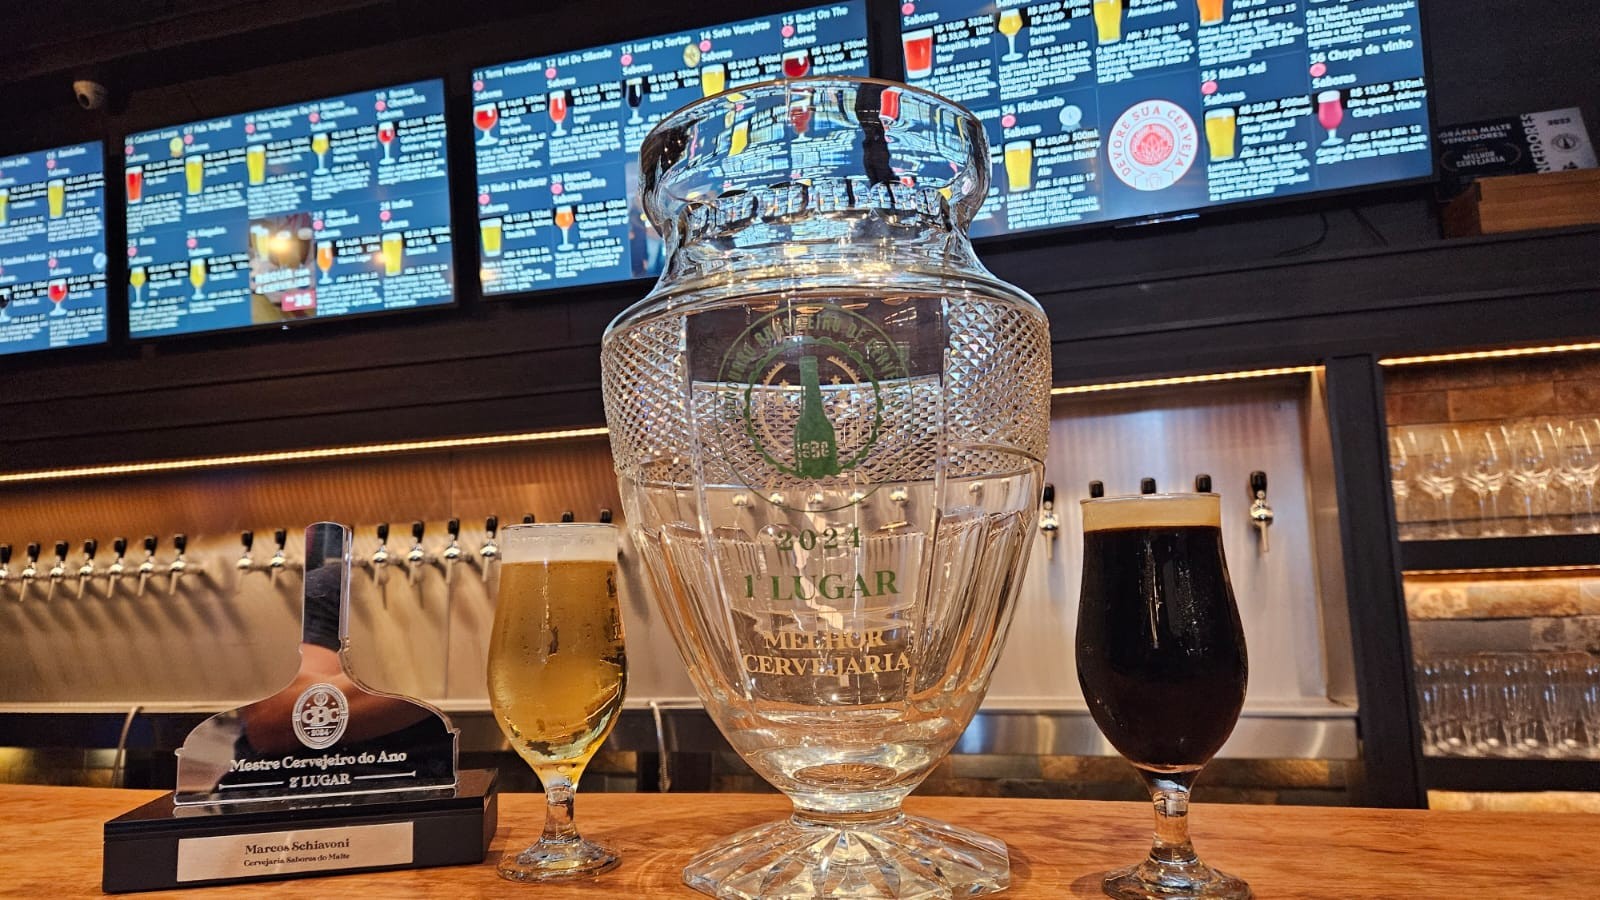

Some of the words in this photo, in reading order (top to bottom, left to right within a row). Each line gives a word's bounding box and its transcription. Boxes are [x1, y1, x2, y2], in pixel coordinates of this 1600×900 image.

[832, 6, 848, 16] The
[904, 11, 939, 26] Sabores
[1310, 52, 1326, 65] 36
[1328, 46, 1362, 63] Chope
[1365, 43, 1380, 56] de
[1382, 37, 1414, 52] vinho
[1313, 73, 1356, 90] Sabores
[1393, 78, 1424, 91] 330ml
[1352, 105, 1380, 119] Chope
[1395, 99, 1421, 112] Vinho
[1004, 124, 1042, 139] Sabores
[1112, 120, 1132, 178] DEVORE
[1132, 106, 1162, 121] SUA
[1167, 110, 1193, 168] CERVEJA
[845, 318, 869, 342] DE
[776, 527, 861, 551] 2024
[770, 570, 901, 600] LUGAR
[764, 630, 888, 650] MELHOR
[742, 652, 911, 677] CERVEJARIA
[229, 758, 280, 772] Mestre
[282, 753, 356, 770] Cervejeiro
[357, 752, 376, 764] do
[377, 750, 408, 763] Ano
[302, 773, 352, 788] LUGAR
[245, 843, 290, 854] Marcos
[291, 838, 350, 851] Schiavoni
[243, 856, 285, 868] Cervejaria
[328, 852, 350, 860] Malte
